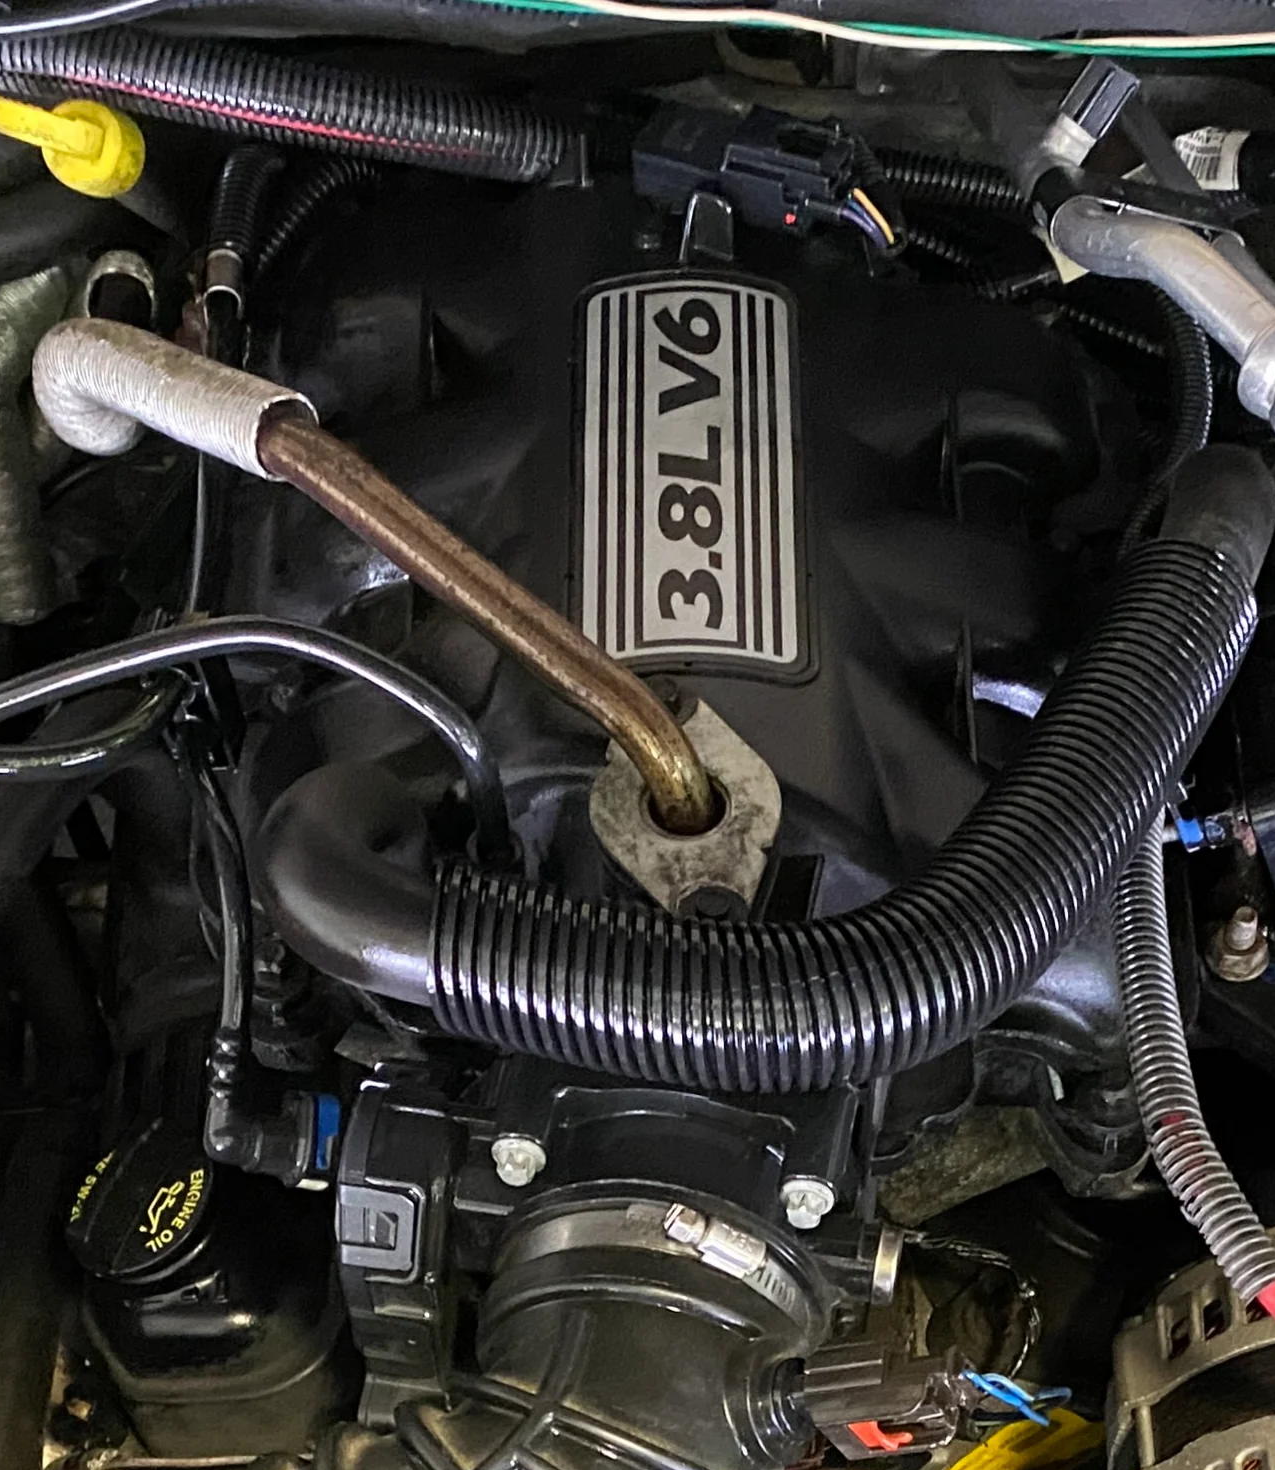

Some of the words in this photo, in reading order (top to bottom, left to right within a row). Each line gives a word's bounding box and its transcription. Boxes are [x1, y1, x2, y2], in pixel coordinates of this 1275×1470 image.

[653, 297, 721, 415] V6
[658, 425, 722, 629] 3.8L
[145, 1230, 174, 1253] OIL
[171, 1168, 204, 1230] ENGINE
